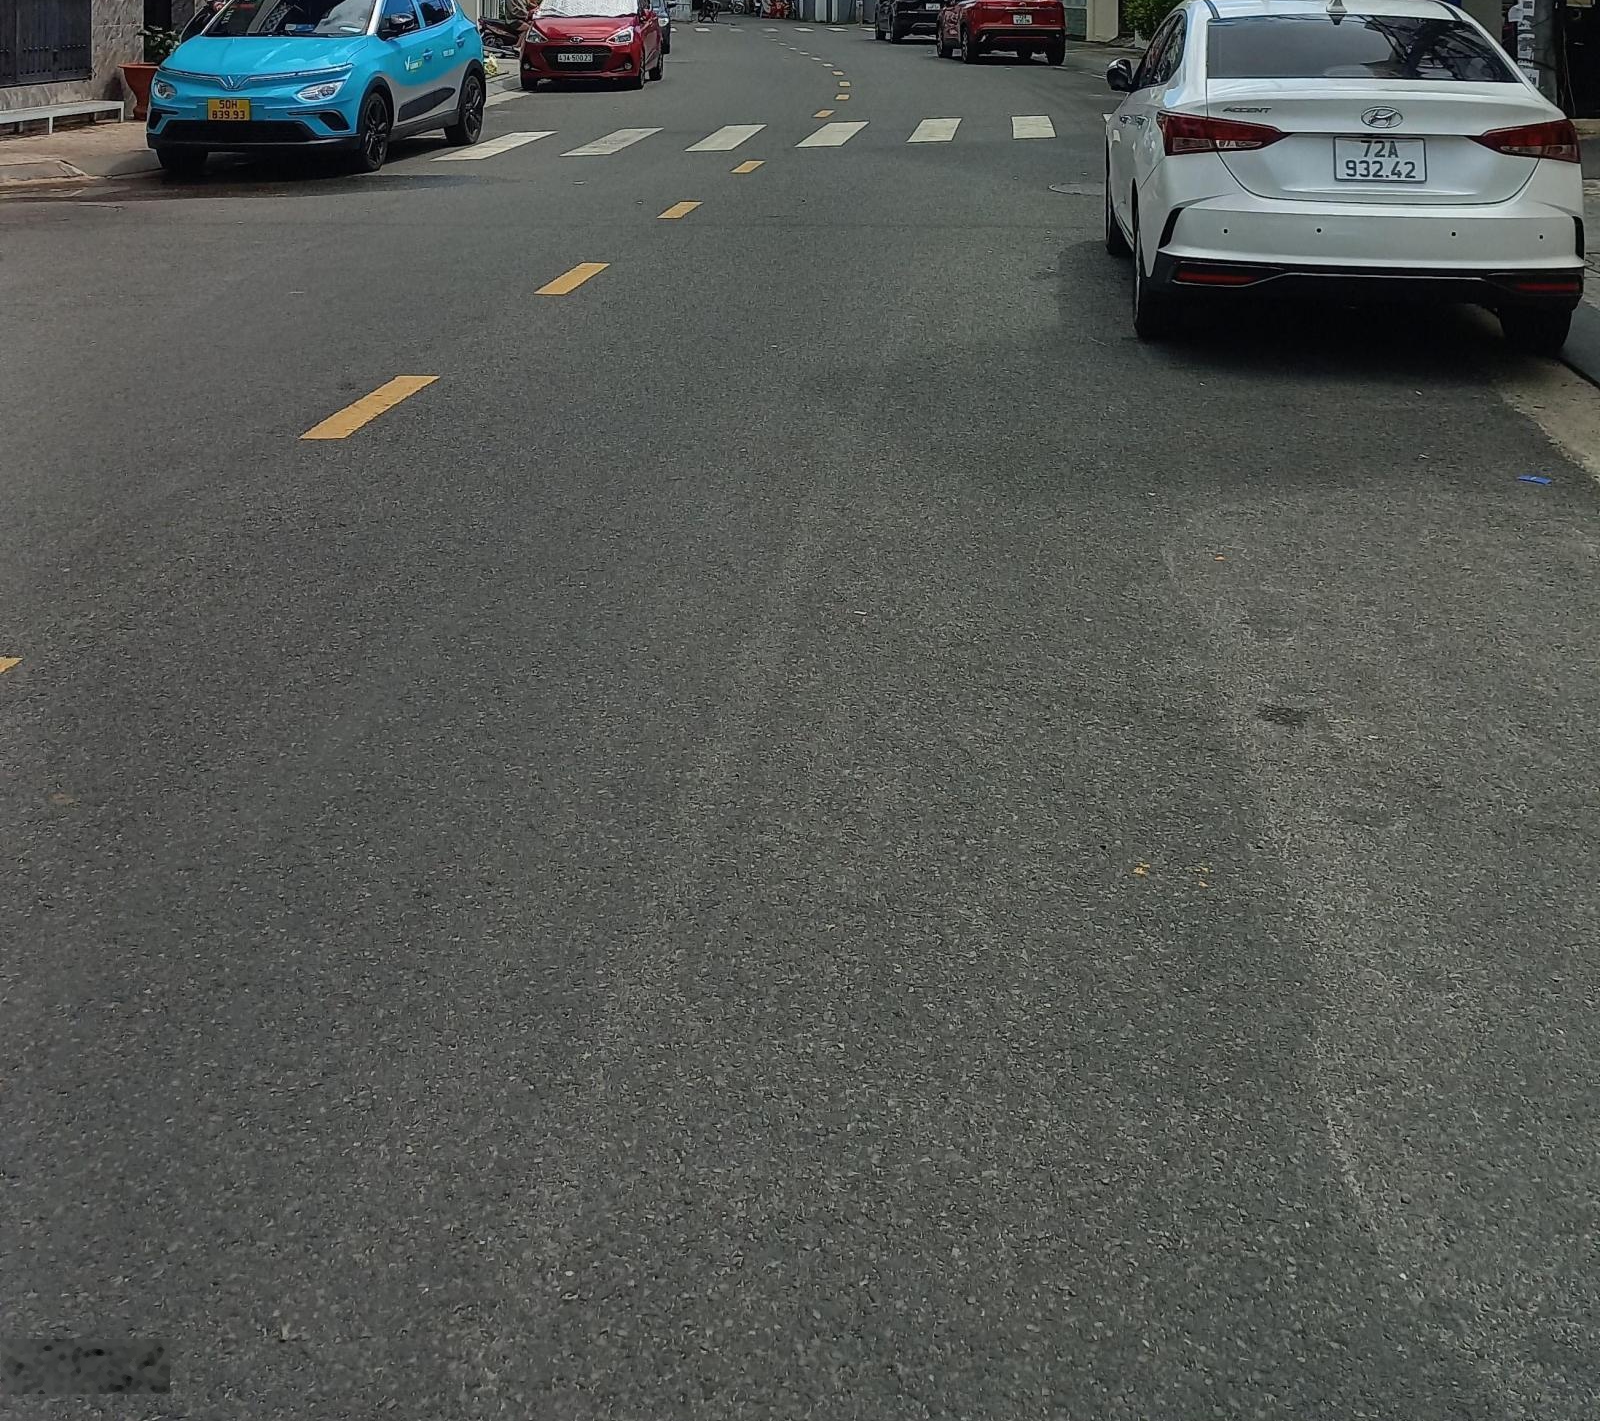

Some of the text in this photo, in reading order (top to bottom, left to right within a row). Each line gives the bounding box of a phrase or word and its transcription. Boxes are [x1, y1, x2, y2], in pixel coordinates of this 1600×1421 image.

[218, 100, 238, 109] 50H
[211, 110, 246, 120] 839.93
[1222, 106, 1272, 114] ACCENT
[1360, 140, 1399, 158] 72A
[1345, 159, 1416, 179] 932.42
